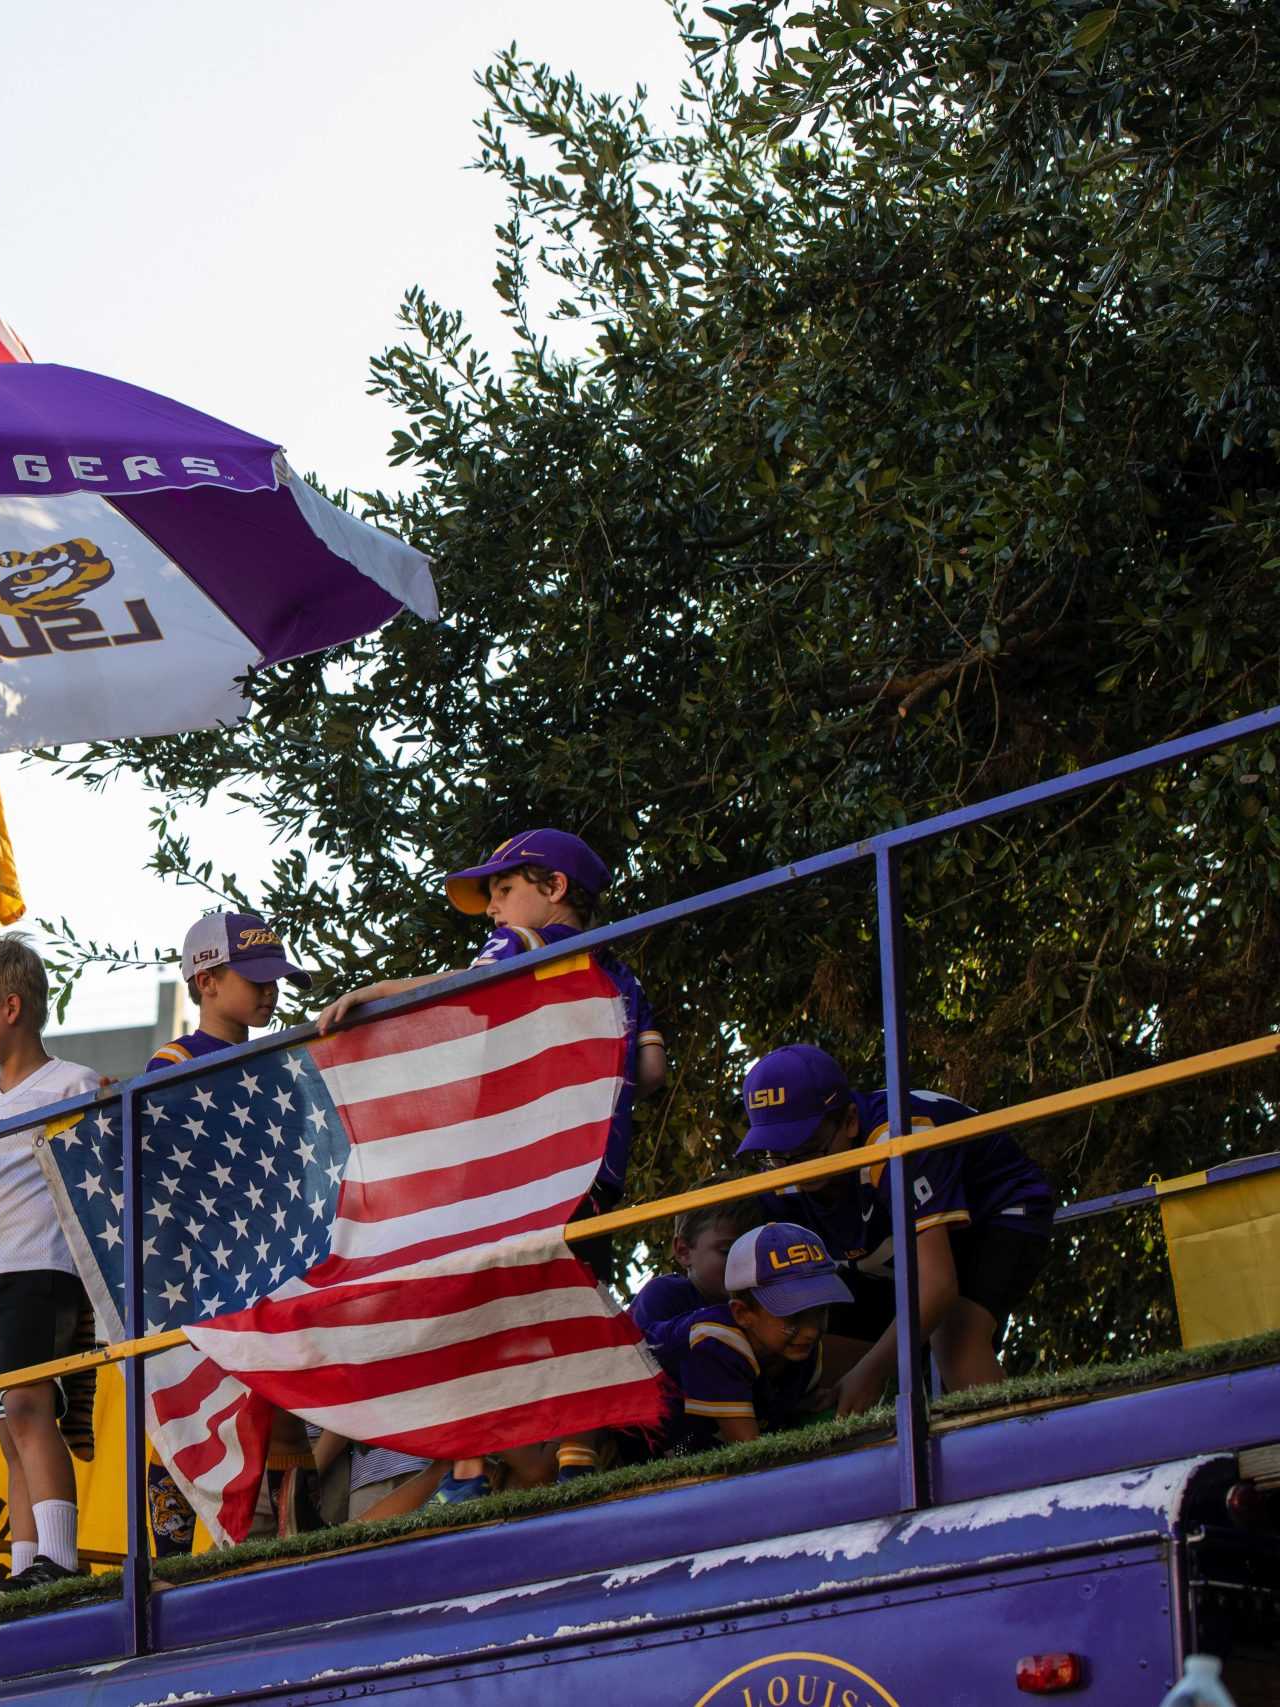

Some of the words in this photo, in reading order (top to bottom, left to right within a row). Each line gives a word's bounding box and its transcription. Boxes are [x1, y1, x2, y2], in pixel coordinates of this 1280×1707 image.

[193, 948, 219, 965] LSU
[748, 1087, 785, 1109] LSU
[769, 1244, 826, 1270] LSU
[742, 1674, 872, 1707] LOUIS
